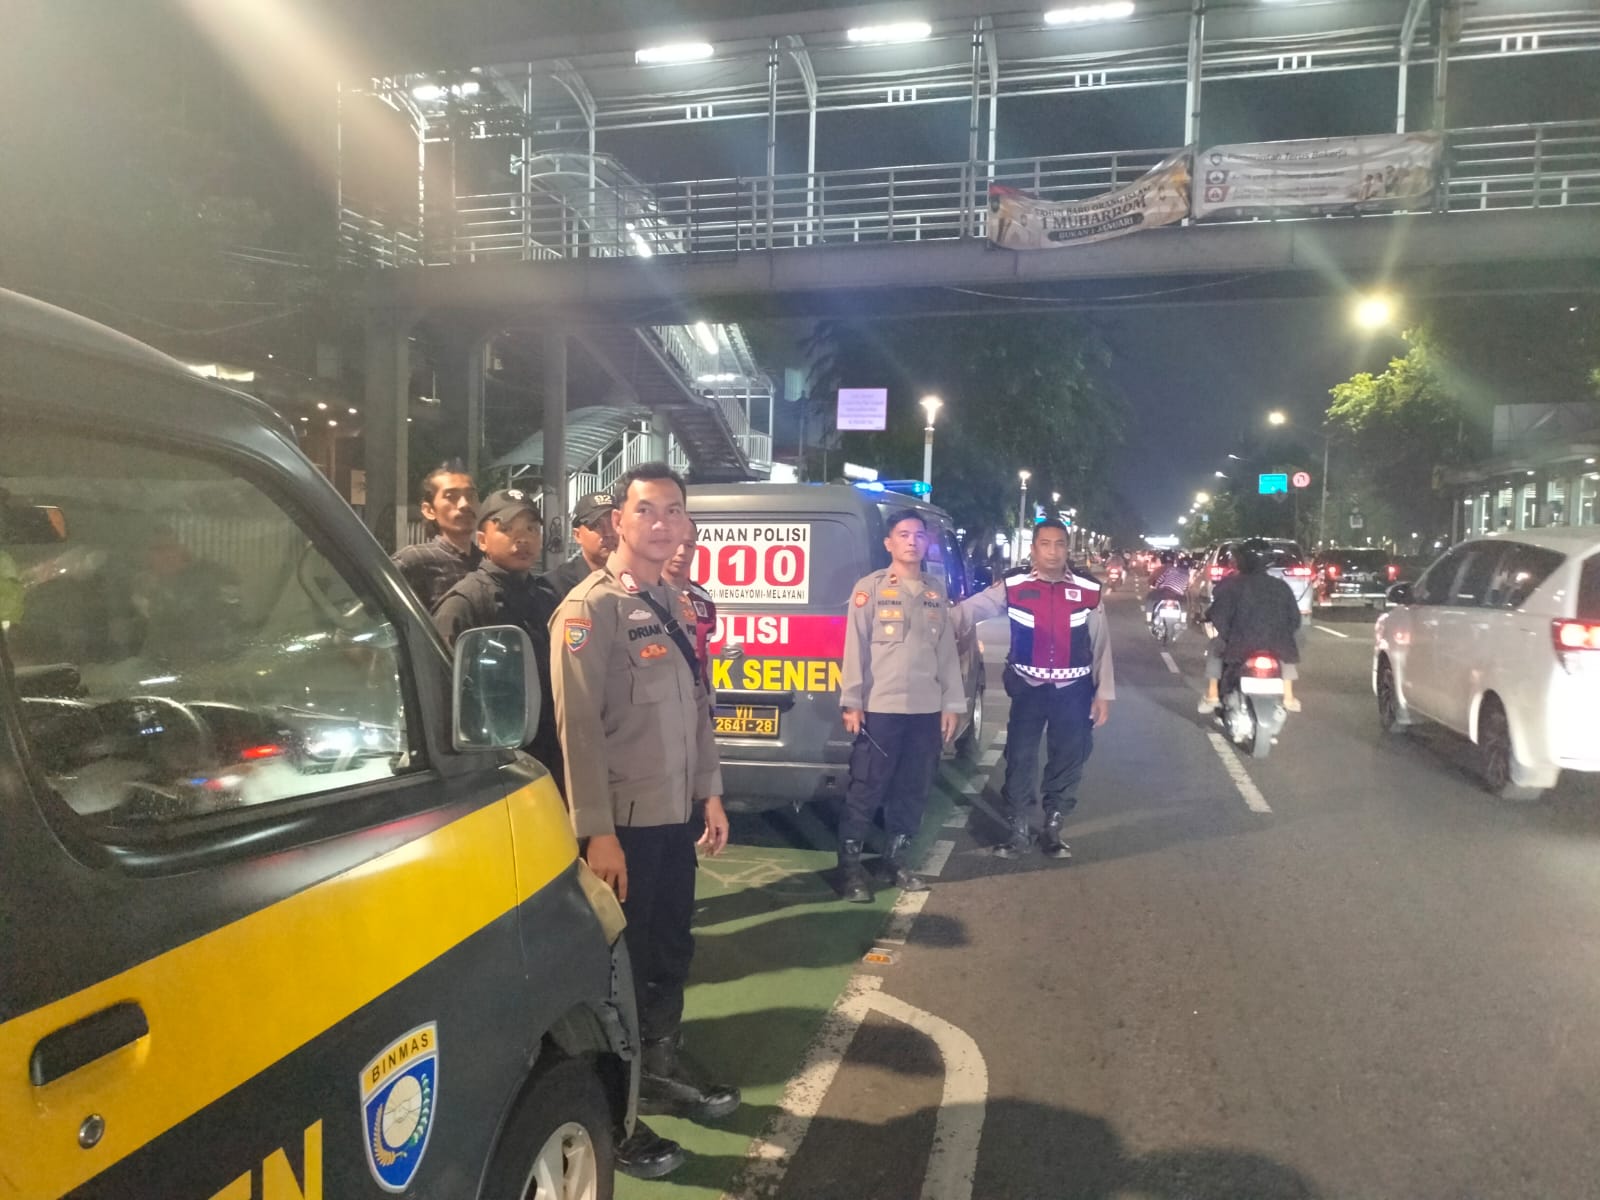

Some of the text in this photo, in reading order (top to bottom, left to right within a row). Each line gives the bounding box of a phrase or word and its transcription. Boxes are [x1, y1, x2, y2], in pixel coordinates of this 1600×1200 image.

[1058, 229, 1089, 240] BUKAN
[696, 528, 807, 542] YANAN POLISI
[710, 615, 789, 645] OLISI
[715, 718, 773, 733] 2641-28
[371, 1032, 429, 1084] BINMAS
